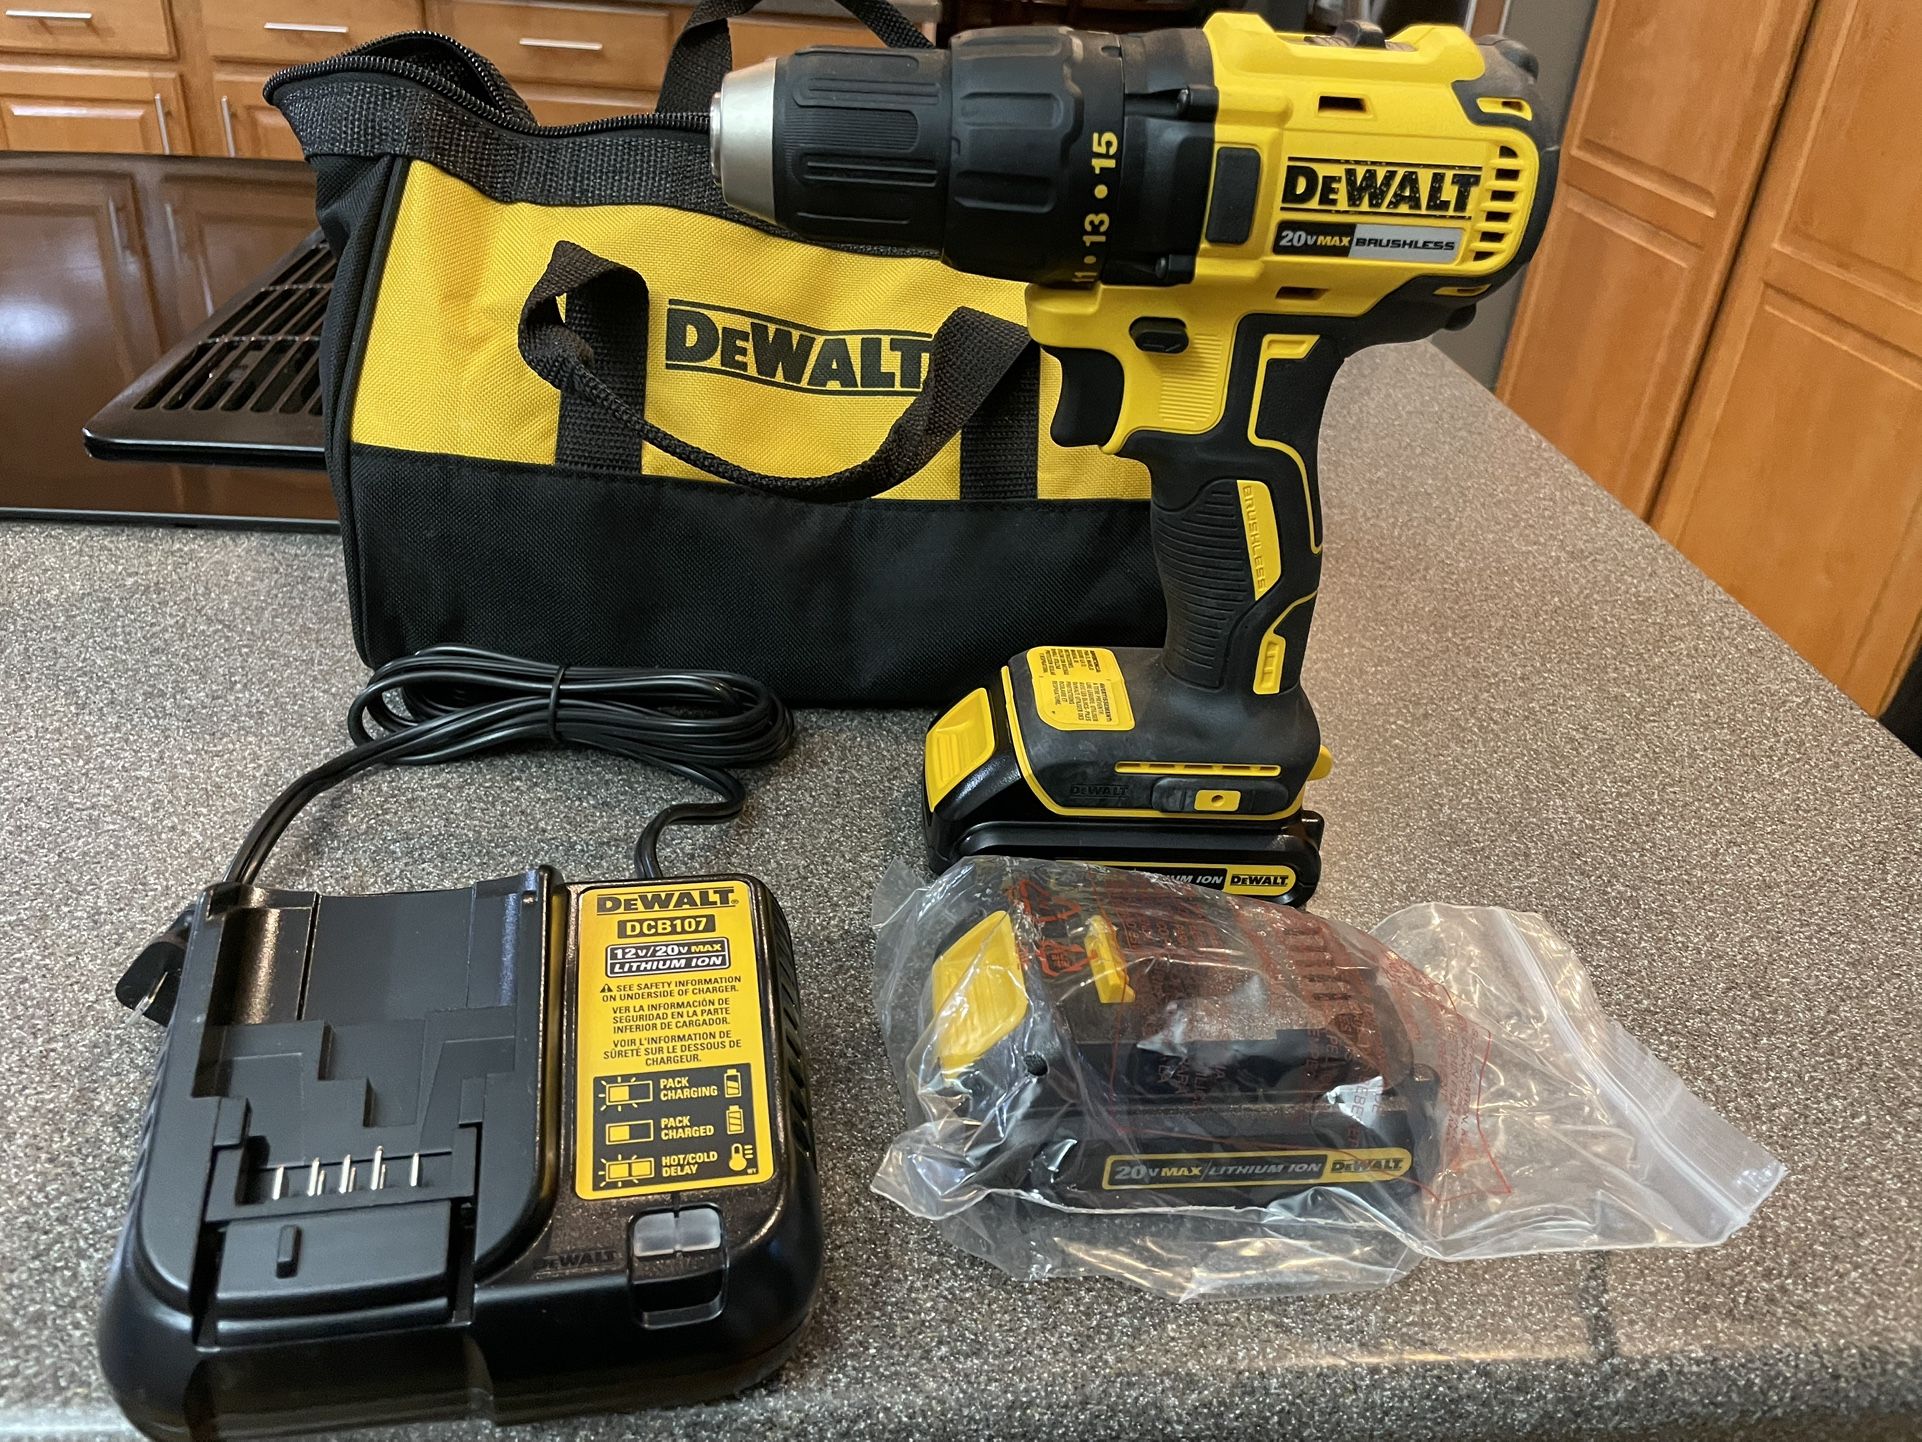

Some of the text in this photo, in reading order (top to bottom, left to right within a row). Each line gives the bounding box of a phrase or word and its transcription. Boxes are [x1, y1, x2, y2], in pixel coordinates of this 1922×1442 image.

[1092, 132, 1118, 174] 15
[1082, 212, 1110, 246] 13
[1317, 236, 1351, 246] MAX
[1355, 236, 1455, 251] BRUSHLESS
[1243, 486, 1266, 590] BRUSHLESS
[1196, 876, 1223, 884] ION
[626, 918, 707, 936] DCB107
[691, 944, 721, 952] MAX
[614, 956, 722, 973] LITHIUM ION
[616, 975, 741, 992] SEE SAFETY INFORMATION
[620, 990, 674, 1001] UNDERSIDE
[678, 988, 690, 996] OF
[692, 984, 738, 994] CHARGER.
[612, 997, 730, 1014] VER LA INFORMACIÓN DE
[613, 1008, 730, 1024] SEGURIDAD EN LA PARTE
[614, 1018, 730, 1034] INFERIOR DE CARGADOR.
[613, 1030, 732, 1048] VOIR L'INFORMATION DE
[603, 1040, 742, 1060] SÛRETÉ SUR LE DESSOUS DE
[646, 1054, 702, 1066] CHARGEUR.
[660, 1077, 688, 1088] PACK
[660, 1086, 718, 1100] CHARGING
[661, 1116, 690, 1128] PACK
[661, 1124, 714, 1140] CHARGED
[662, 1151, 718, 1166] HOT/COLD
[662, 1164, 698, 1177] DELAY
[1161, 1167, 1201, 1177] MAX
[1208, 1164, 1283, 1175] LITHIUM
[1288, 1162, 1322, 1172] ION
